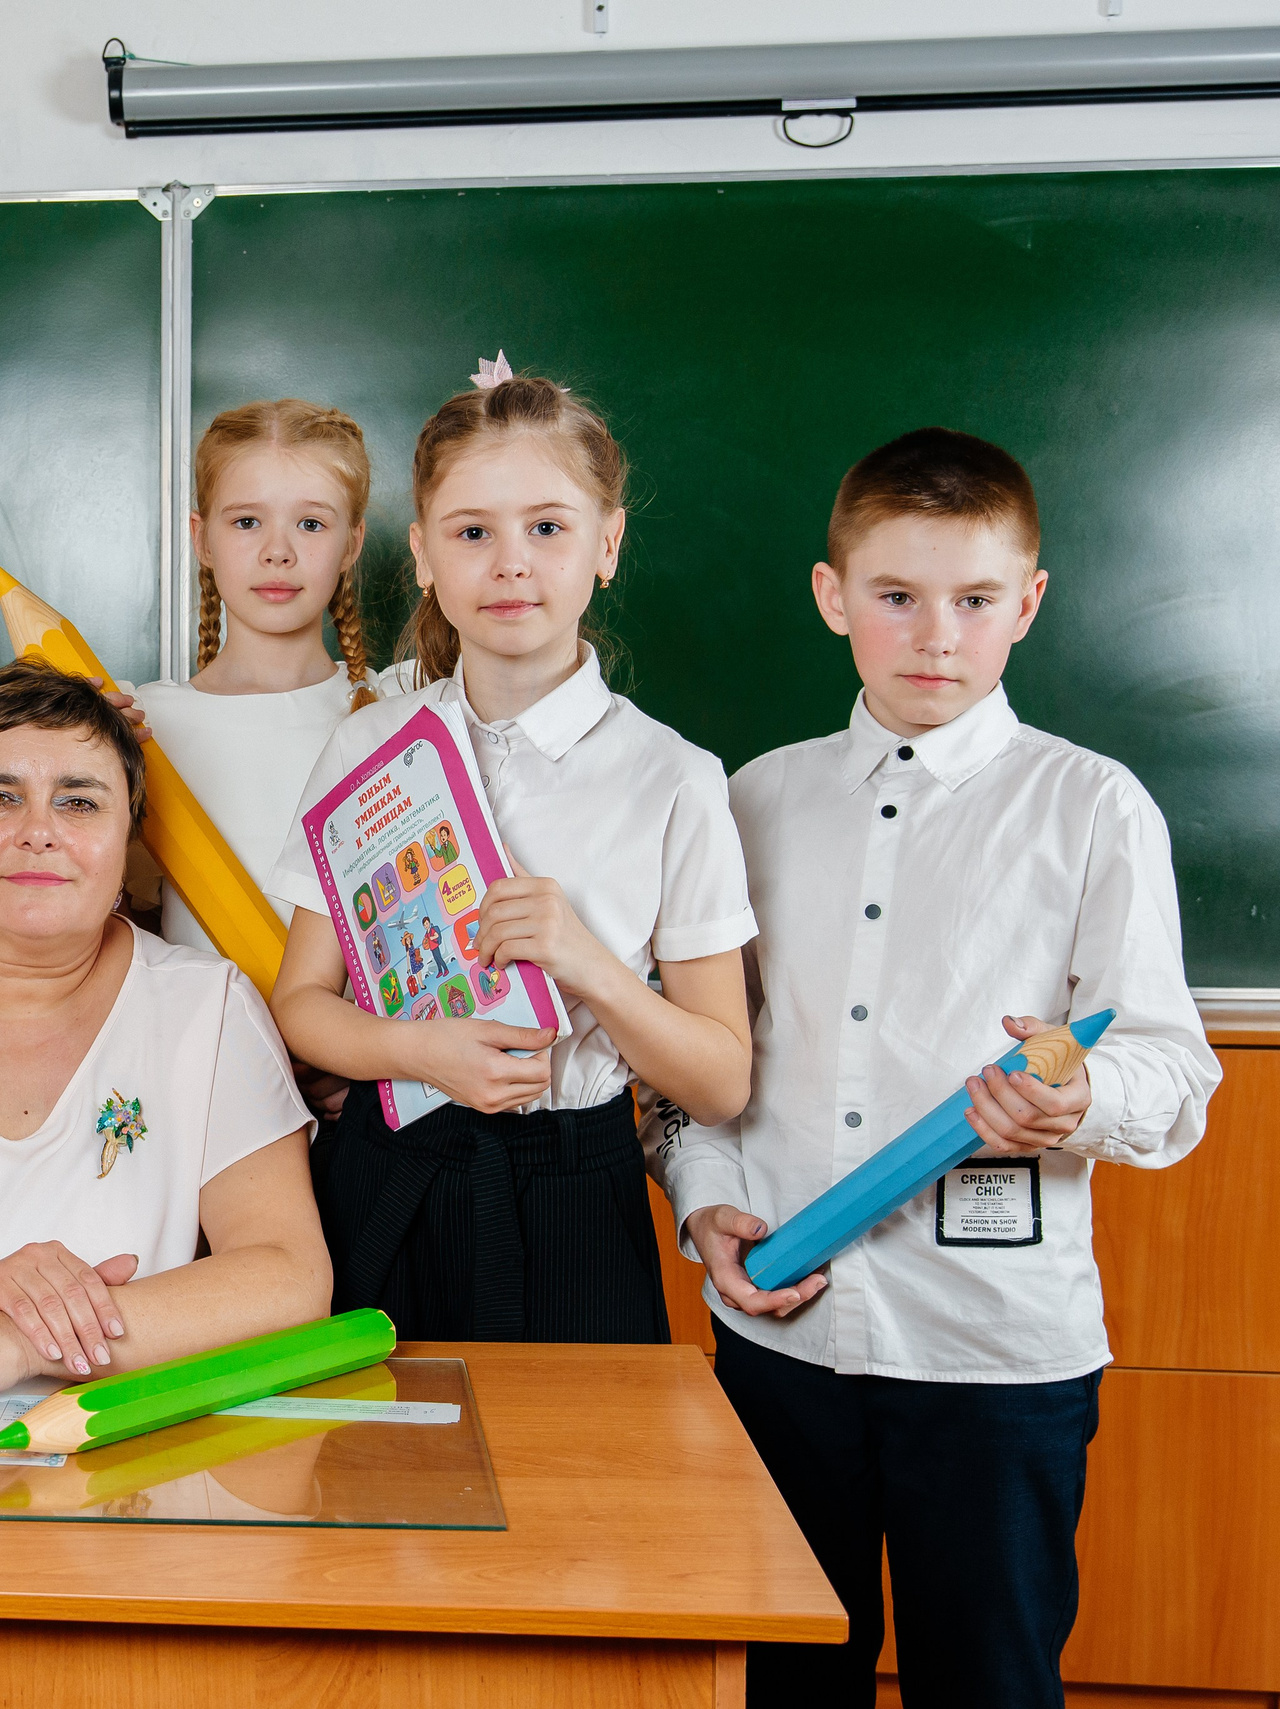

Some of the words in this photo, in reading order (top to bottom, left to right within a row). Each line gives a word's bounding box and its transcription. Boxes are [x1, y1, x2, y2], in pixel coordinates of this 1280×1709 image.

[354, 785, 402, 829] УМНИКАМ
[358, 773, 392, 807] ЮНЫМ
[342, 843, 378, 878] Информатика,
[378, 825, 400, 846] логика,
[400, 793, 440, 827] математика
[364, 796, 413, 841] УМНИЦАМ
[388, 831, 417, 857] социальный
[417, 809, 445, 835] интеллект)
[442, 880, 452, 896] 4
[452, 877, 470, 892] класс
[447, 889, 466, 903] часть
[466, 884, 472, 892] 2
[309, 825, 332, 887] РАЗВИТИЕ
[331, 894, 370, 1006] ПОЗНАВАТЕЛЬНЫХ
[961, 1174, 1016, 1184] CREATIVE
[976, 1186, 1003, 1196] CHIC
